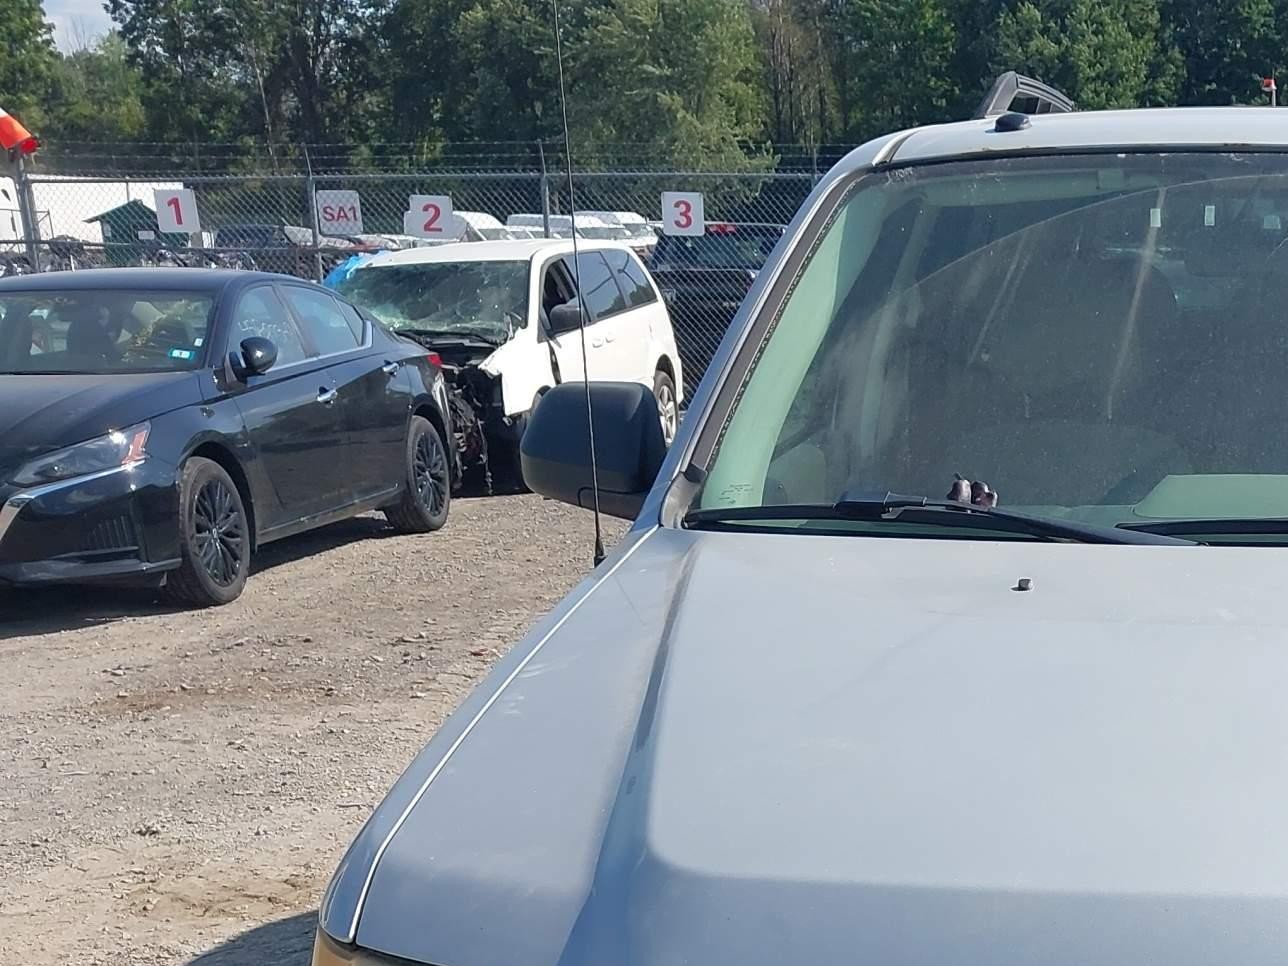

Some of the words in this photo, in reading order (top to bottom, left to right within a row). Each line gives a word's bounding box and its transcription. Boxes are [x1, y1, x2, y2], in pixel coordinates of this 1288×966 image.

[167, 197, 183, 225] 1
[322, 205, 359, 223] SA1
[422, 203, 443, 232] 2
[673, 200, 693, 229] 3
